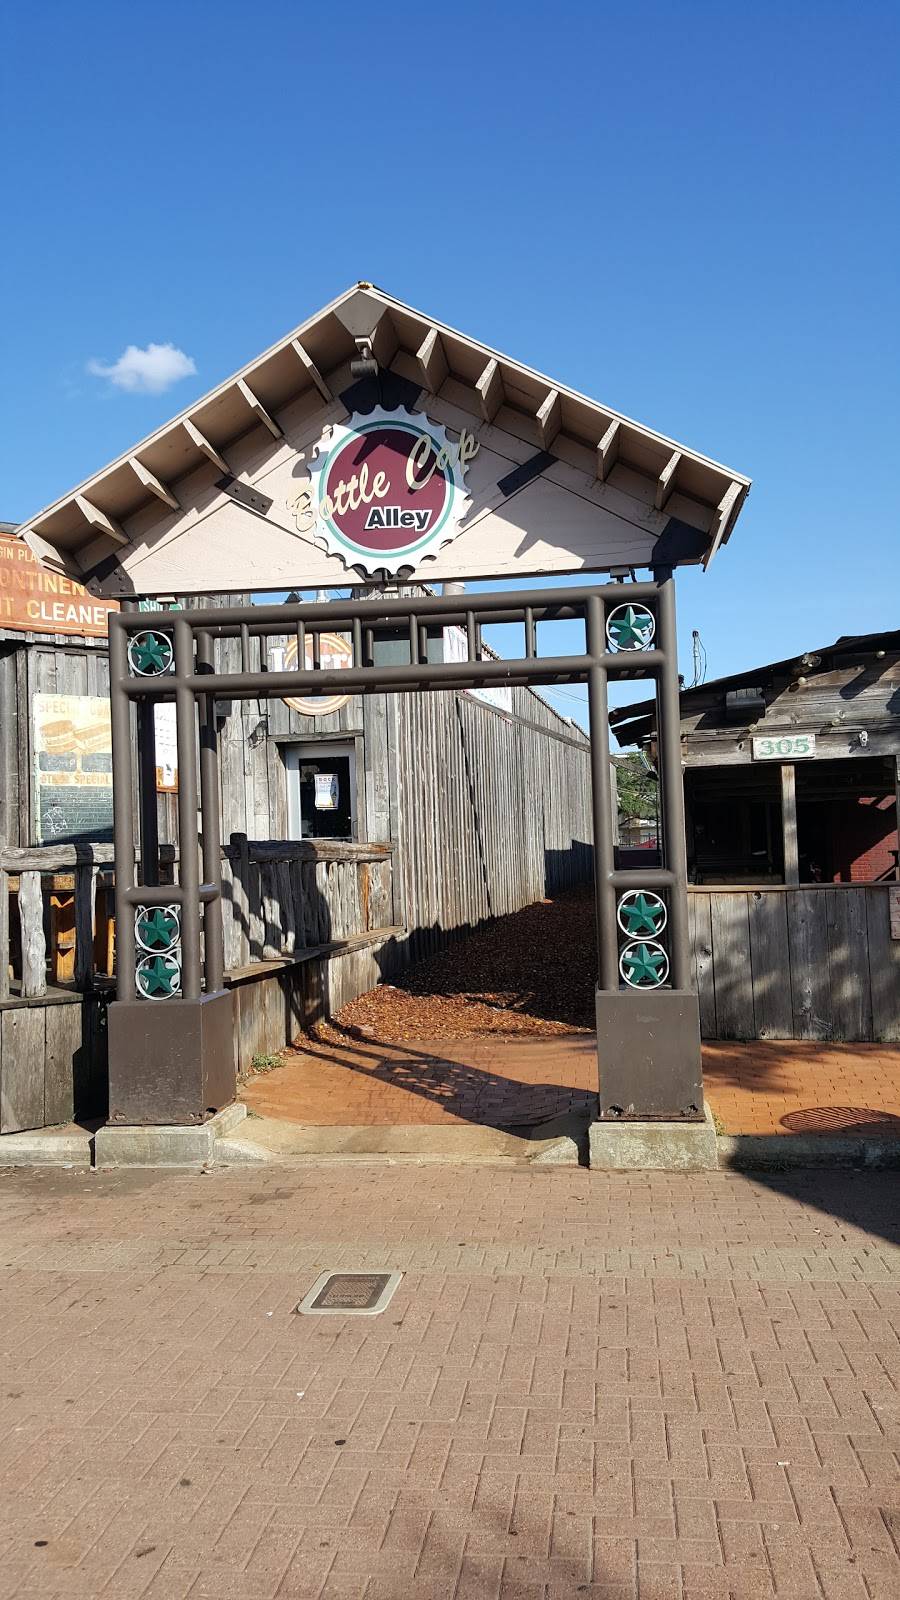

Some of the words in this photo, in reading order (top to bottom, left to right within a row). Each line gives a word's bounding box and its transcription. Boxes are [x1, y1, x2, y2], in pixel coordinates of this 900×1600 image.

[286, 462, 390, 533] Bottle
[405, 428, 480, 490] Cap
[364, 506, 432, 532] Alley
[18, 549, 40, 564] PLA
[0, 567, 93, 598] ONTINEN
[759, 737, 810, 756] 305
